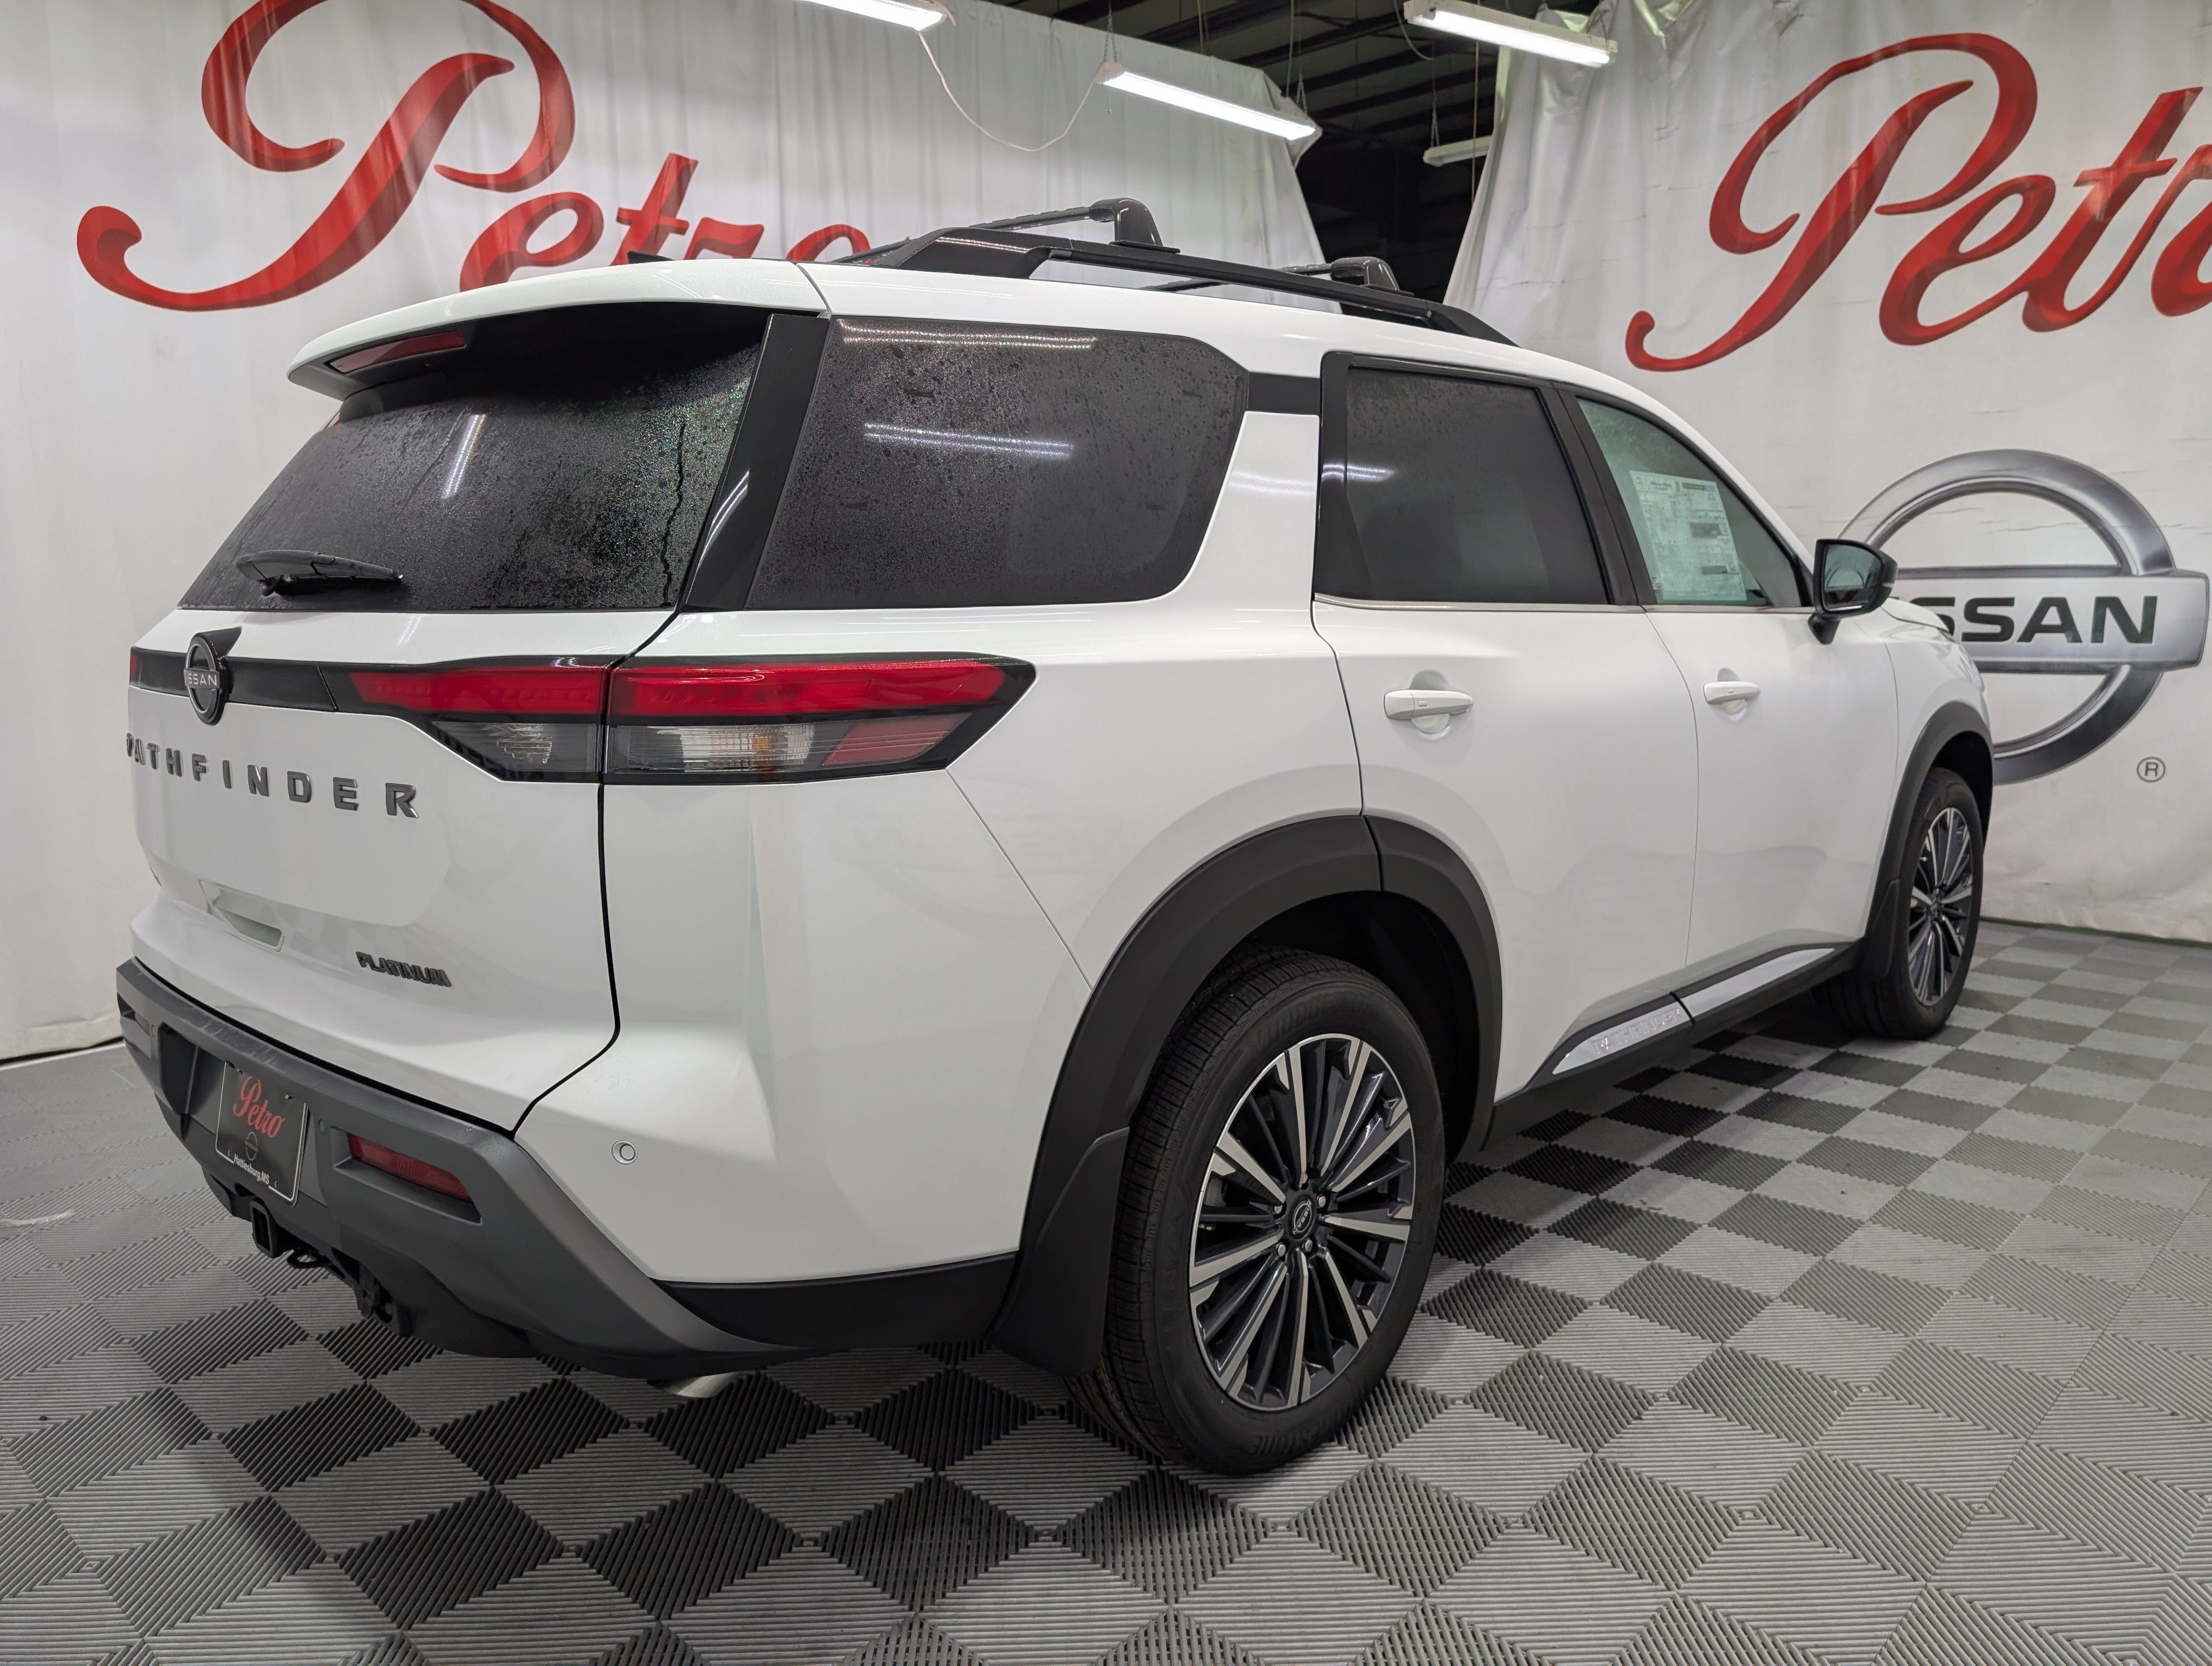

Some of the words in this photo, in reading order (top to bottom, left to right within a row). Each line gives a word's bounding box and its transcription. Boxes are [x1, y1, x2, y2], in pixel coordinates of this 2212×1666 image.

[126, 732, 419, 818] PATHFINDER
[355, 951, 452, 988] PLATINUM
[232, 1076, 286, 1138] Petro
